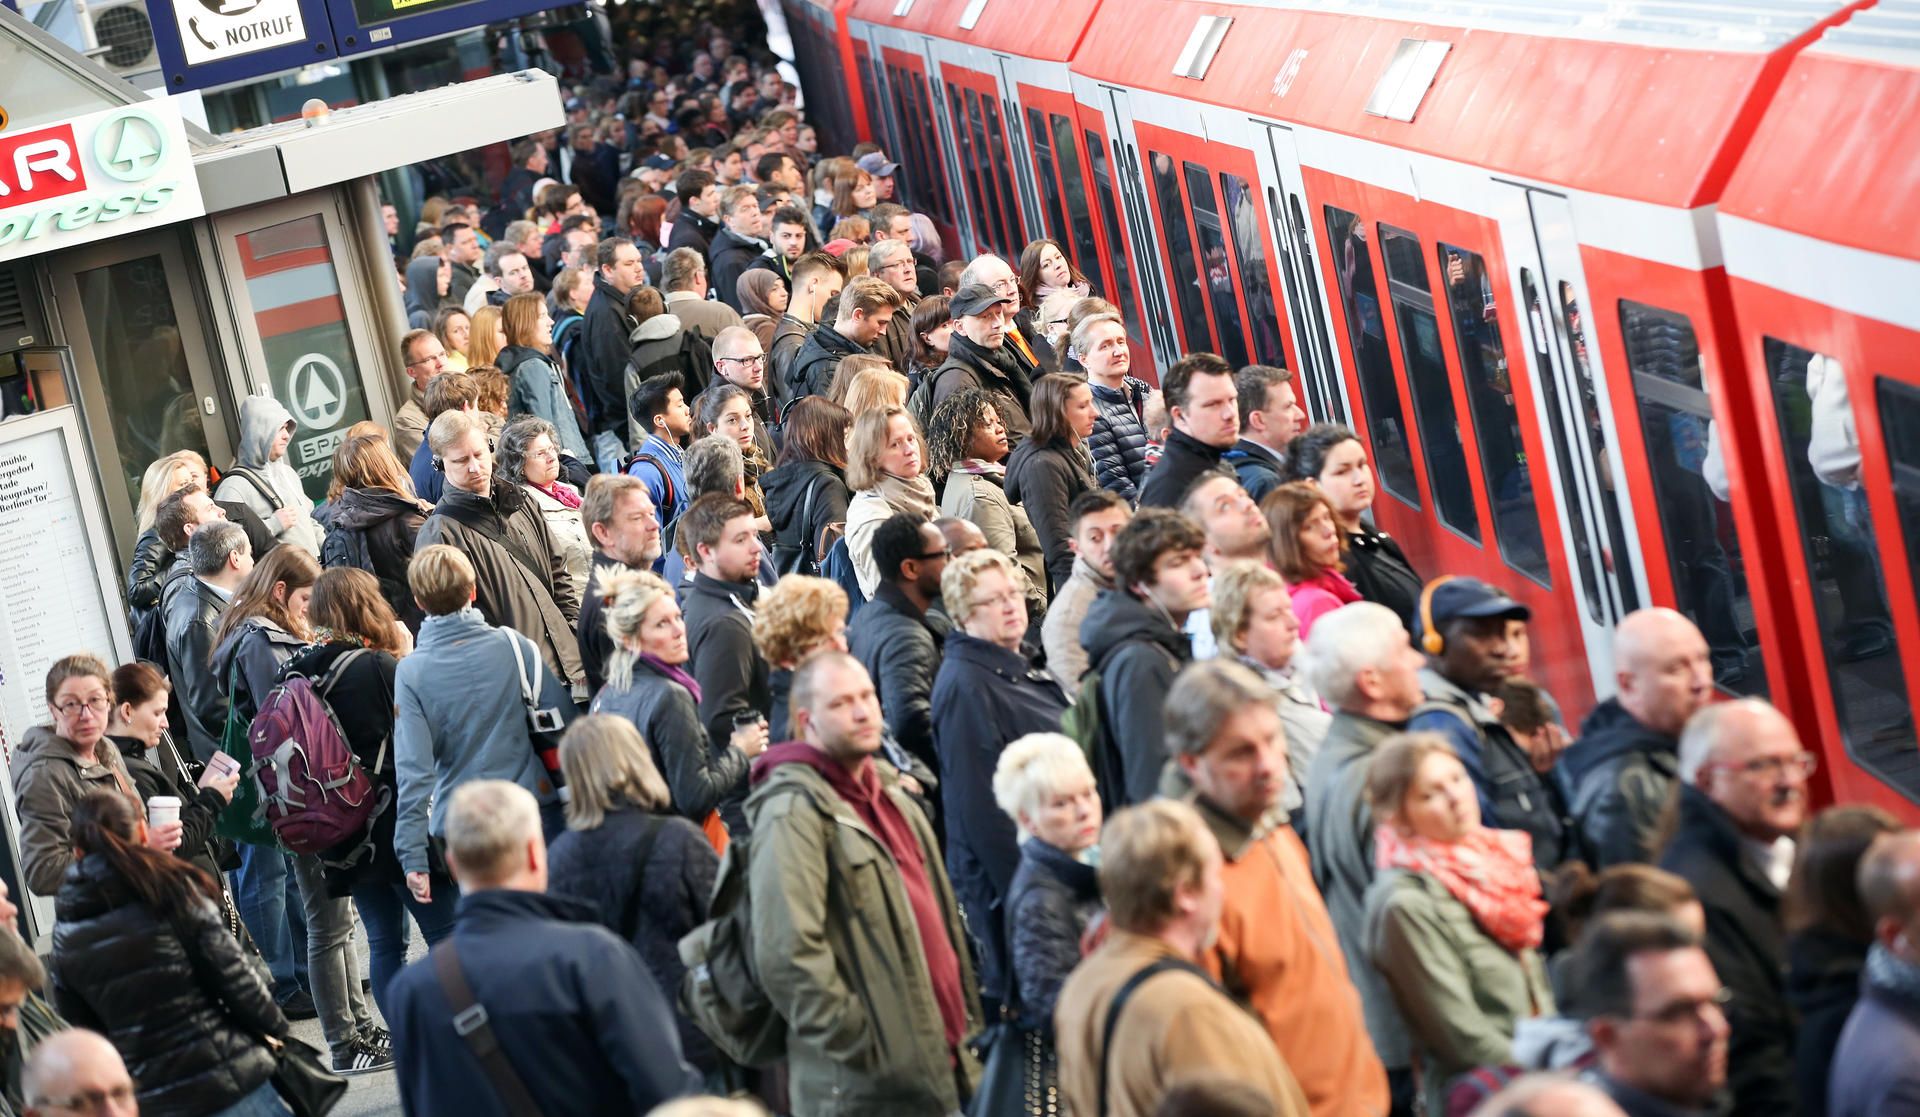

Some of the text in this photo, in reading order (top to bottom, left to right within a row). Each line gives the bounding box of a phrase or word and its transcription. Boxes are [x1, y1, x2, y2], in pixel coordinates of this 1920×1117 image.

[224, 14, 293, 46] NOTRUF
[0, 138, 77, 197] R
[302, 434, 344, 458] SPA
[0, 454, 27, 468] mühle
[297, 459, 334, 478] exp
[0, 494, 47, 513] Berliner Tor
